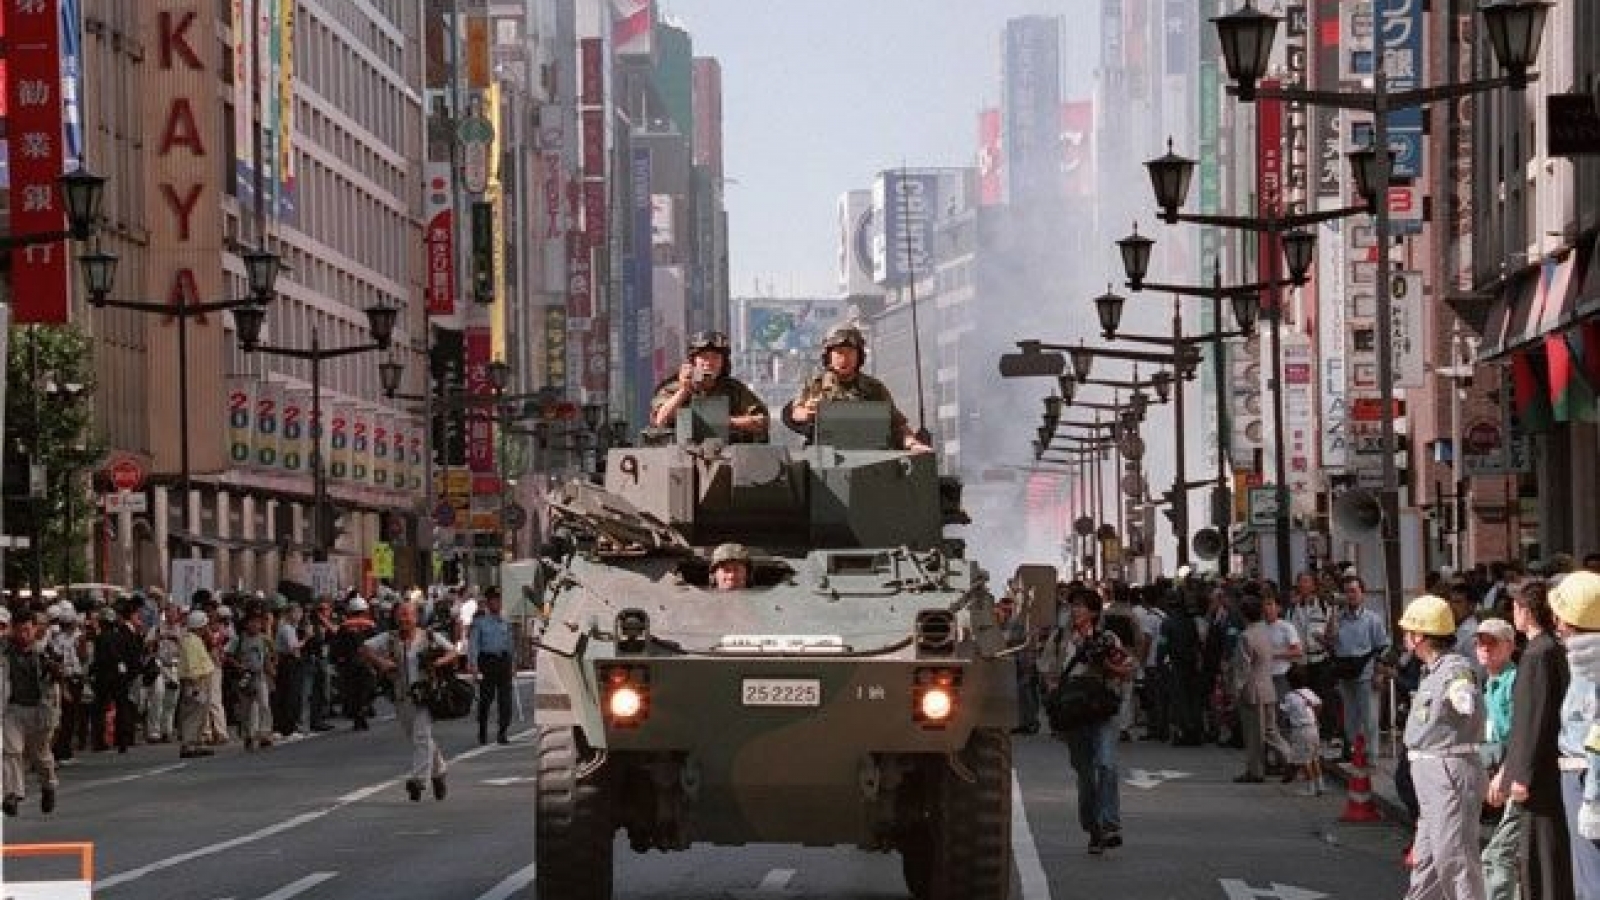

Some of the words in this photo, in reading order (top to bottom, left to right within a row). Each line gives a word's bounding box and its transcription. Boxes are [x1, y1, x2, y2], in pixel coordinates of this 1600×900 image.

[230, 392, 248, 461] 200
[258, 400, 276, 466] 200
[284, 406, 301, 470] 200
[331, 418, 346, 478] 200
[620, 454, 638, 485] 9
